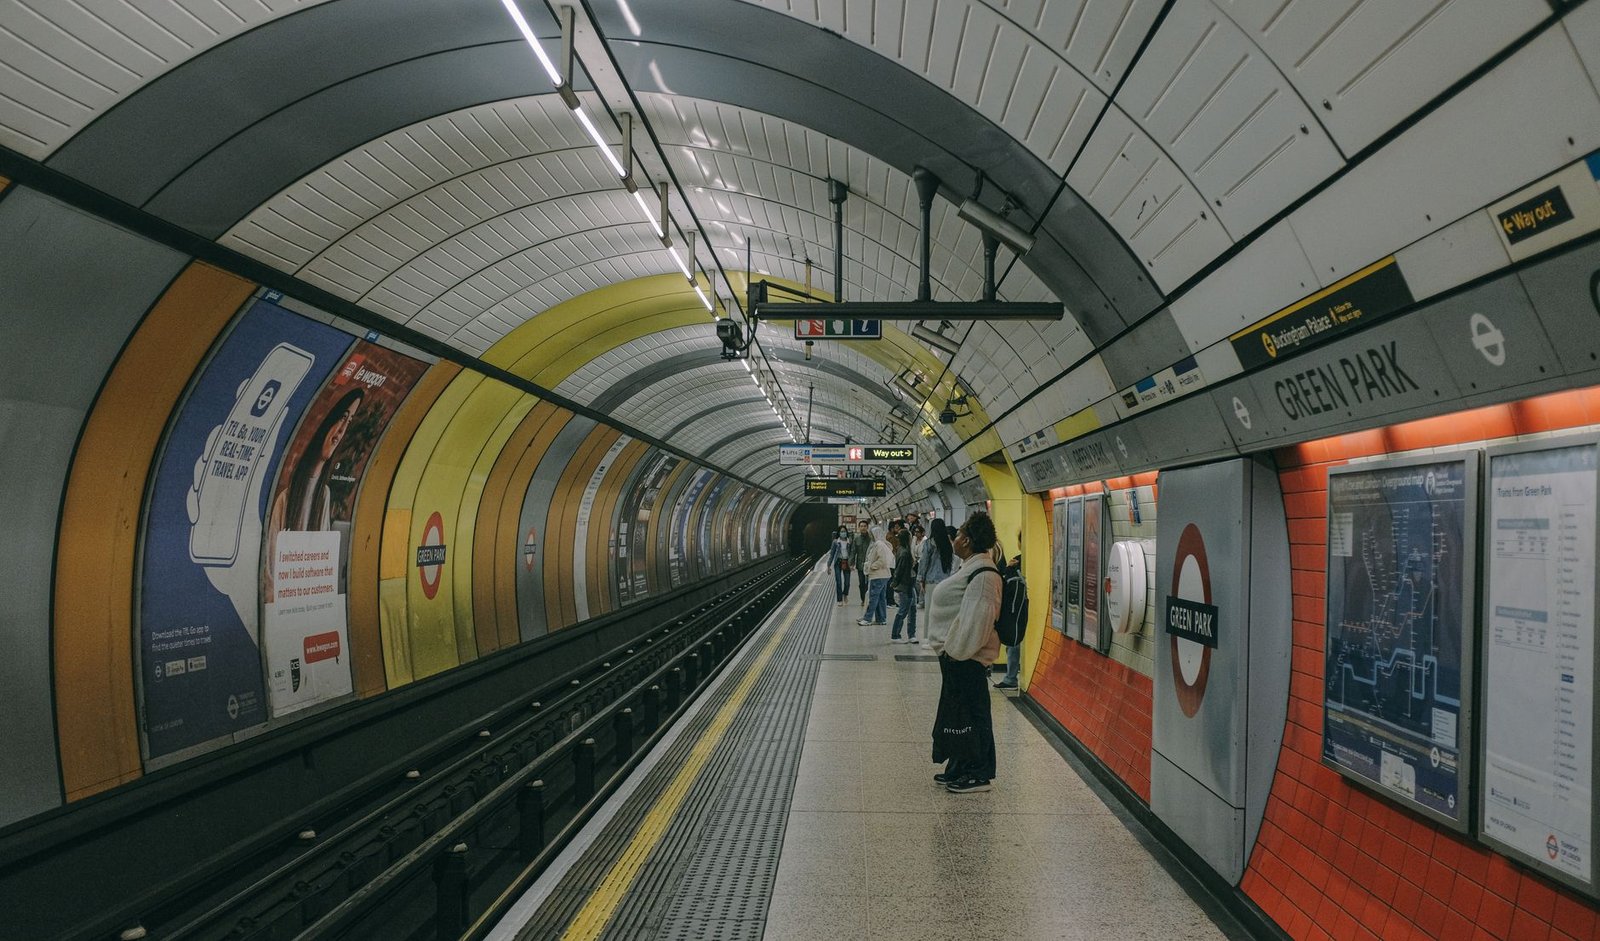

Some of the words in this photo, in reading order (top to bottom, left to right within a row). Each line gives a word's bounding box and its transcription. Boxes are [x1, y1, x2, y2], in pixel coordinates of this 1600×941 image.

[1511, 210, 1536, 231] Way
[1535, 200, 1557, 220] out
[1271, 325, 1311, 350] Buckingham
[1305, 316, 1332, 335] Palace
[1274, 363, 1349, 421] GREEN
[1340, 341, 1420, 404] PARK
[220, 440, 255, 462] REAL-TIME
[873, 449, 890, 459] Way
[890, 450, 904, 458] out
[211, 460, 235, 480] TRAVEL
[234, 464, 249, 481] APP
[1524, 486, 1540, 497] Green
[1540, 484, 1553, 496] Park
[282, 550, 304, 562] switched
[304, 552, 320, 561] careers
[320, 550, 330, 560] and
[418, 549, 434, 562] GREEN
[433, 548, 446, 561] PARK
[278, 571, 289, 580] now
[292, 567, 304, 579] build
[304, 567, 324, 578] software
[324, 566, 333, 576] that
[278, 587, 297, 598] matters
[302, 587, 311, 596] our
[311, 584, 335, 595] customers.
[1170, 605, 1192, 631] GREEN
[1194, 610, 1213, 638] PARK
[152, 629, 175, 641] Download
